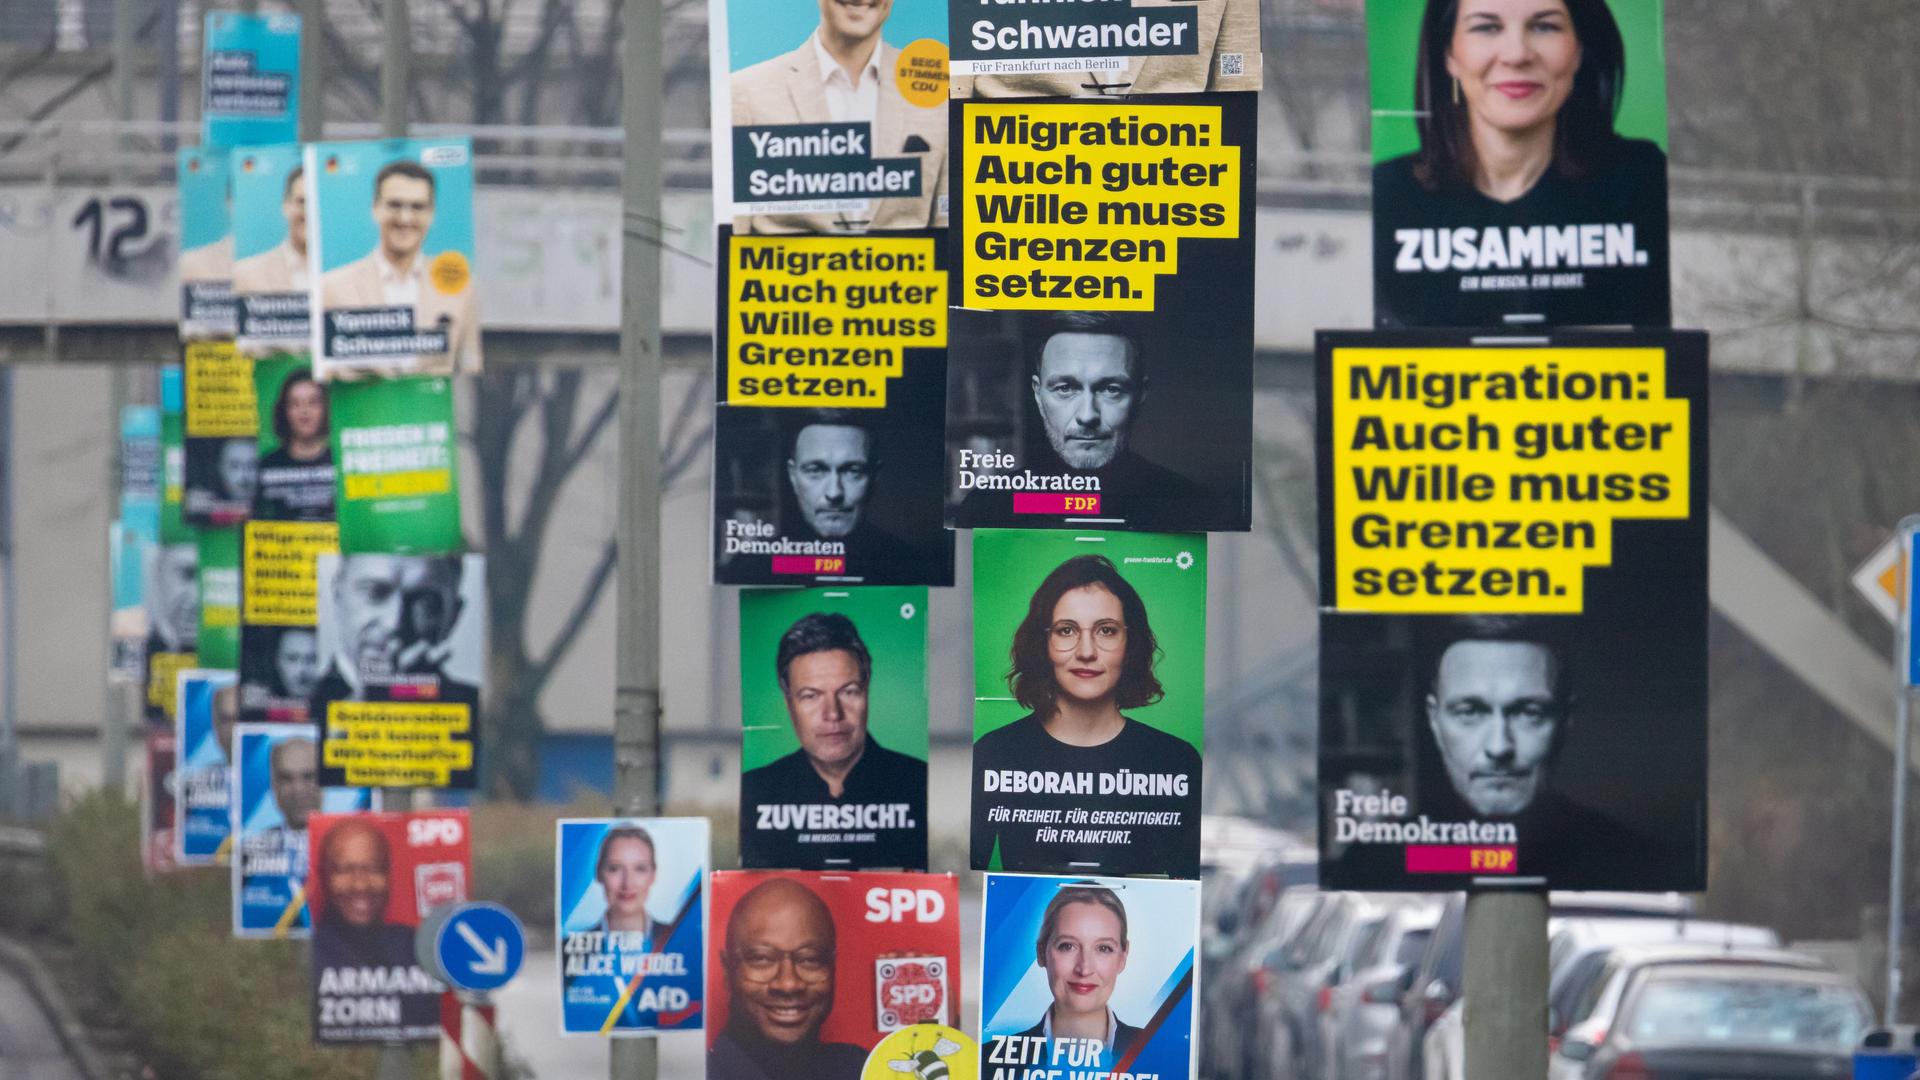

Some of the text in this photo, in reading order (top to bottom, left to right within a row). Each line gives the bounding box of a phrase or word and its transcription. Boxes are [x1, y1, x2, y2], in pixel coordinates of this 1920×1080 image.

[972, 17, 1188, 50] Schwander
[911, 57, 942, 68] BEIDE
[972, 59, 1120, 72] Für Frankfurt nach Berlin
[911, 81, 939, 92] CDU
[749, 128, 865, 157] Yannick
[975, 115, 1210, 151] Migration:
[750, 166, 915, 195] Schwander
[975, 155, 1228, 192] Auch guter
[975, 194, 1226, 226] Wille muss
[975, 231, 1165, 262] Grenzen
[1395, 223, 1648, 272] ZUSAMMEN.
[739, 246, 925, 276] Migration:
[739, 278, 938, 309] Auch guter
[975, 269, 1143, 299] setzen.
[1459, 275, 1479, 291] EIN
[1481, 274, 1530, 290] MENSCH.
[1532, 273, 1551, 288] EIN
[740, 312, 936, 337] Wille muss
[739, 342, 893, 366] Grenzen
[738, 373, 876, 397] setzen.
[1349, 363, 1650, 409] Migration:
[1350, 414, 1673, 460] Auch guter
[959, 449, 1015, 468] Freie
[959, 470, 1101, 490] Demokraten
[1352, 465, 1671, 502] Wille muss
[1064, 497, 1097, 510] FDP
[726, 519, 775, 537] Freie
[1351, 513, 1595, 549] Grenzen
[726, 536, 845, 555] Demokraten
[815, 559, 842, 571] FDP
[1353, 561, 1567, 596] setzen.
[984, 769, 1189, 797] DEBORAH DÜRING
[1335, 789, 1408, 815] Freie
[757, 804, 915, 830] ZUVERSICHT.
[988, 806, 1181, 825] FÜR FREIHEIT. FÜR GERECHTIGKEIT.
[1036, 827, 1131, 844] FÜR FRANKFURT.
[1335, 816, 1517, 843] Demokraten
[1471, 850, 1513, 869] FDP
[865, 887, 945, 923] SPD
[564, 930, 645, 954] ZEIT FÜR
[565, 952, 687, 977] ALICE WEIDEL
[319, 966, 447, 994] ARMAN
[638, 986, 689, 1012] AfD
[889, 984, 936, 1005] SPD
[319, 997, 401, 1026] ZORN
[988, 1035, 1104, 1067] ZEIT FÜR
